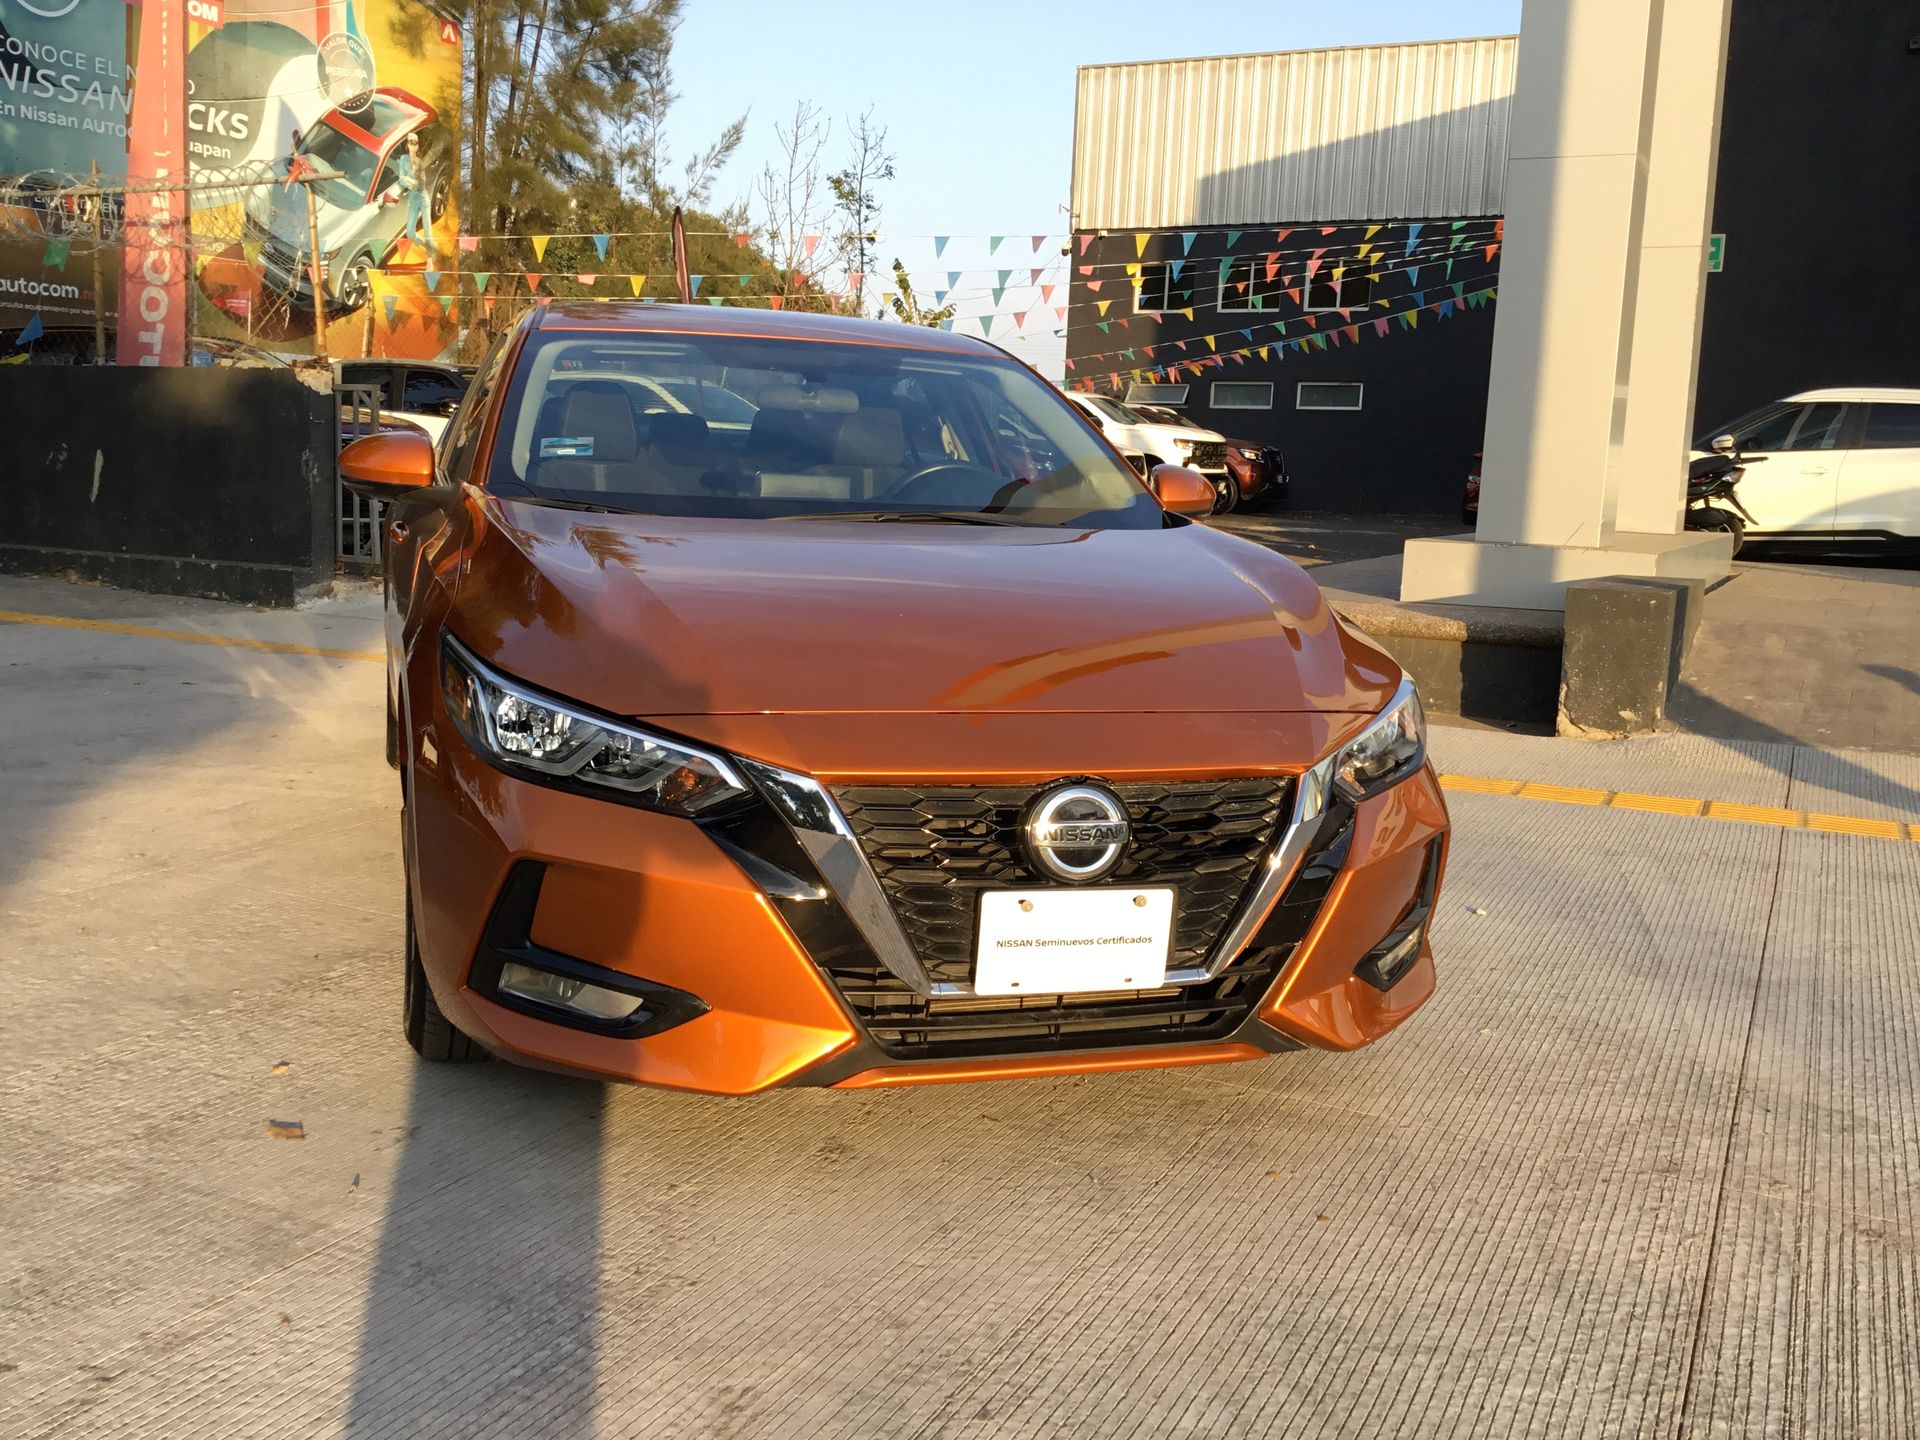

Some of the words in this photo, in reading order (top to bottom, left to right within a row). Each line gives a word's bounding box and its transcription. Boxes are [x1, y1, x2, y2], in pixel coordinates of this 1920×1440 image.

[95, 57, 119, 78] EL
[0, 61, 133, 115] NISSAN
[20, 104, 78, 129] Nissan
[1043, 825, 1119, 842] NISSAN
[996, 939, 1033, 948] NISSAN
[1035, 937, 1094, 947] Seminuevos
[1096, 935, 1153, 945] Certificados
